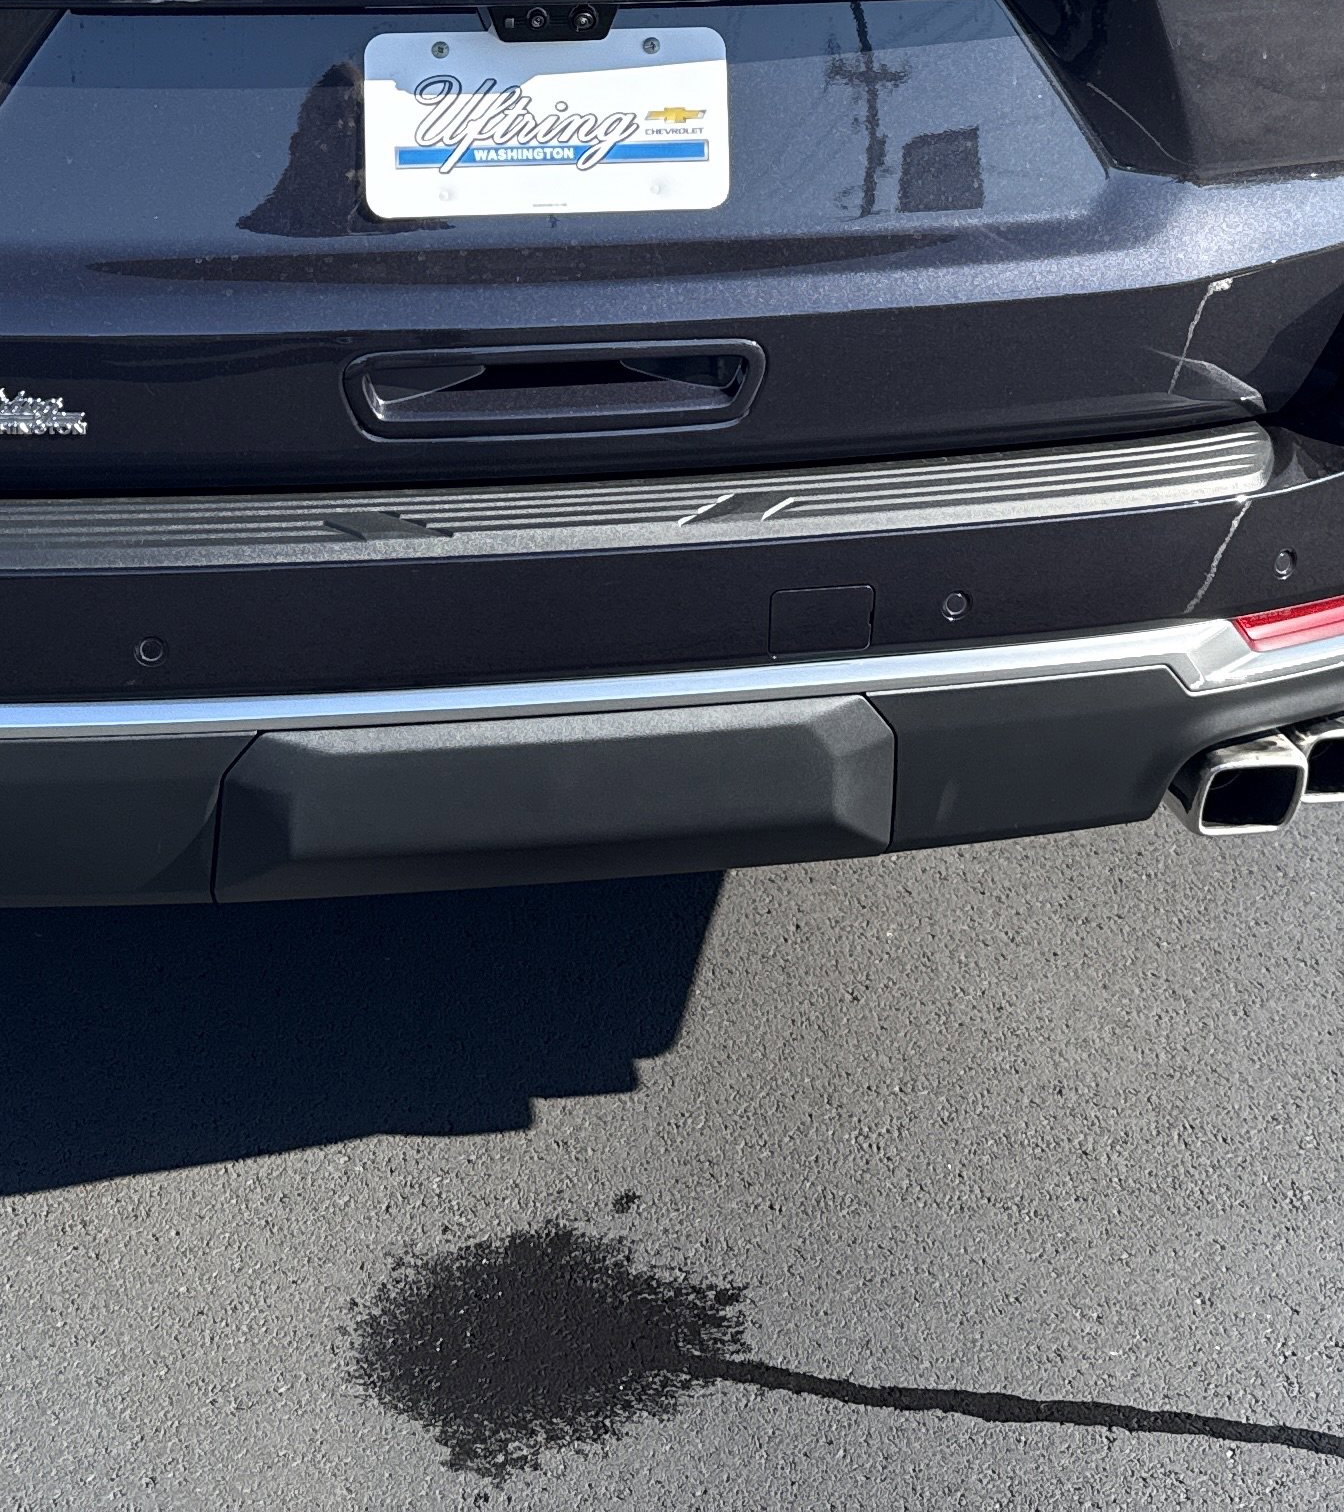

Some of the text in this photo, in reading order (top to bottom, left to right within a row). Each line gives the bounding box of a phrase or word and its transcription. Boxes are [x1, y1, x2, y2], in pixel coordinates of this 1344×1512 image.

[414, 74, 640, 175] Uftring
[644, 127, 704, 136] CHEVROLET
[473, 147, 575, 161] WASHINGTON
